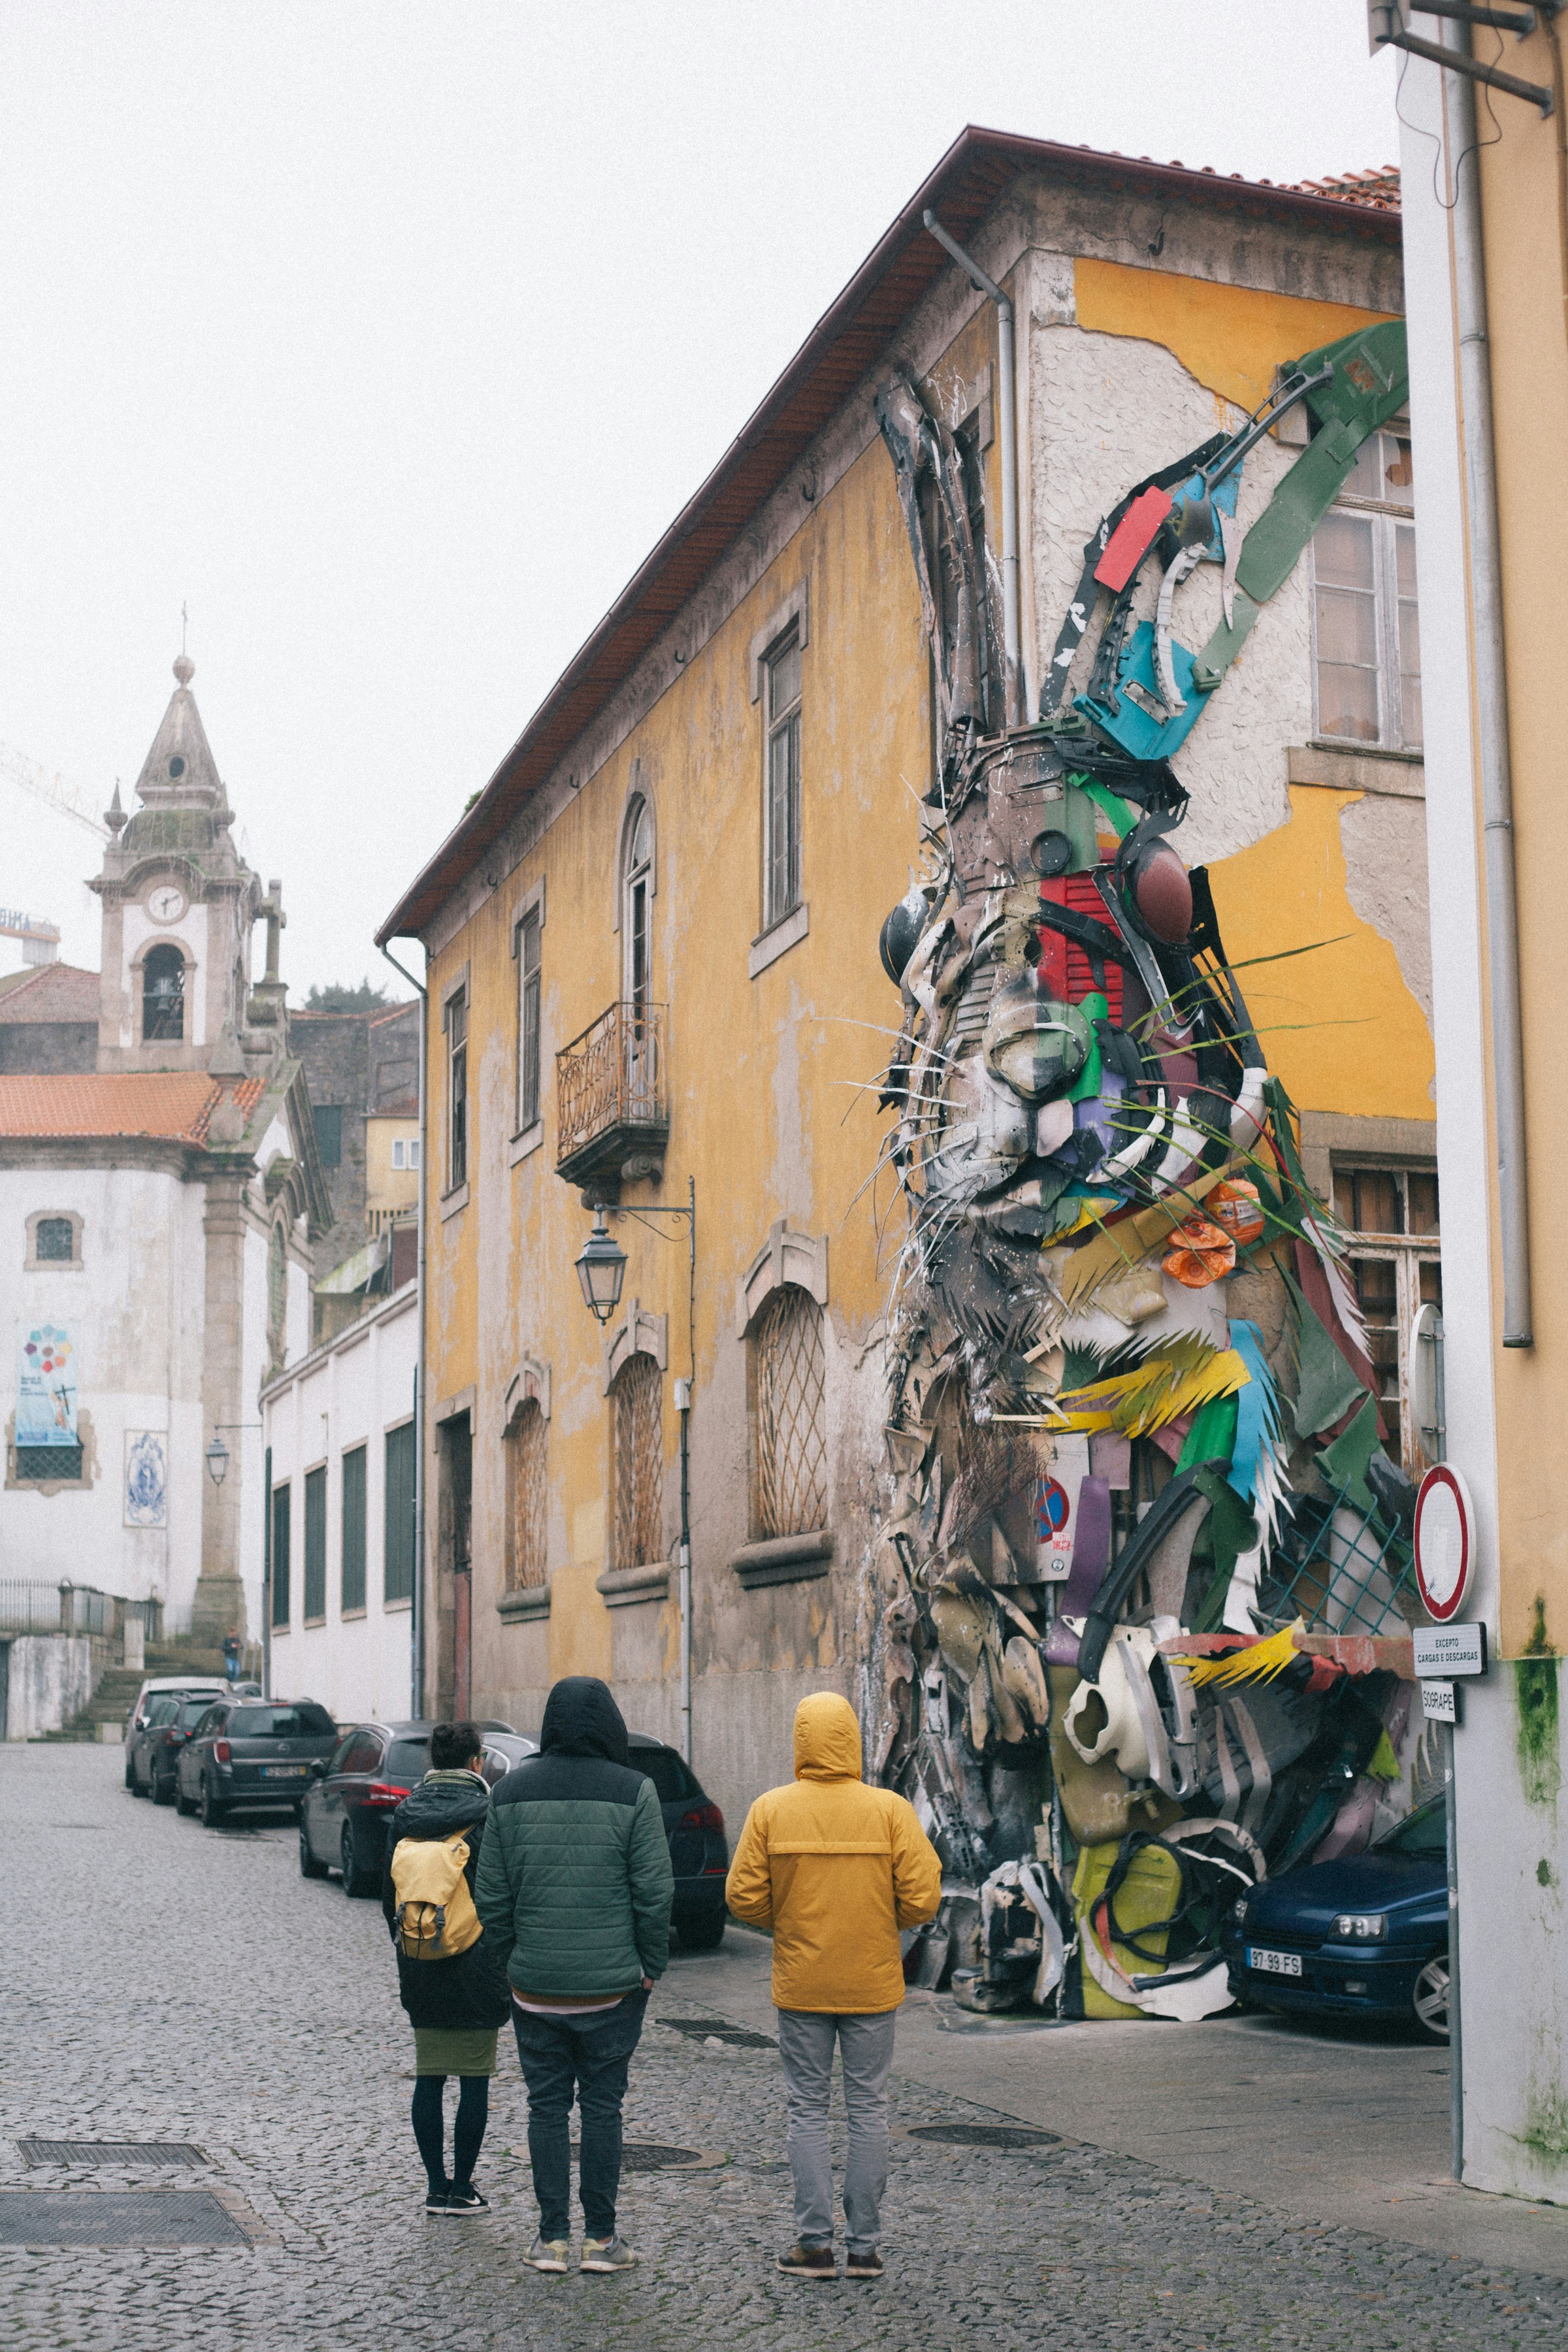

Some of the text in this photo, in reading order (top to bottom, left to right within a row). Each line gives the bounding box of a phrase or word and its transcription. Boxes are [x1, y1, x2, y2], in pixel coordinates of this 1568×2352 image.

[1435, 1638, 1459, 1648] EXCEPTO
[1417, 1651, 1478, 1663] CARGAS E DESCARGAS
[1423, 1690, 1454, 1711] SOGRAPE
